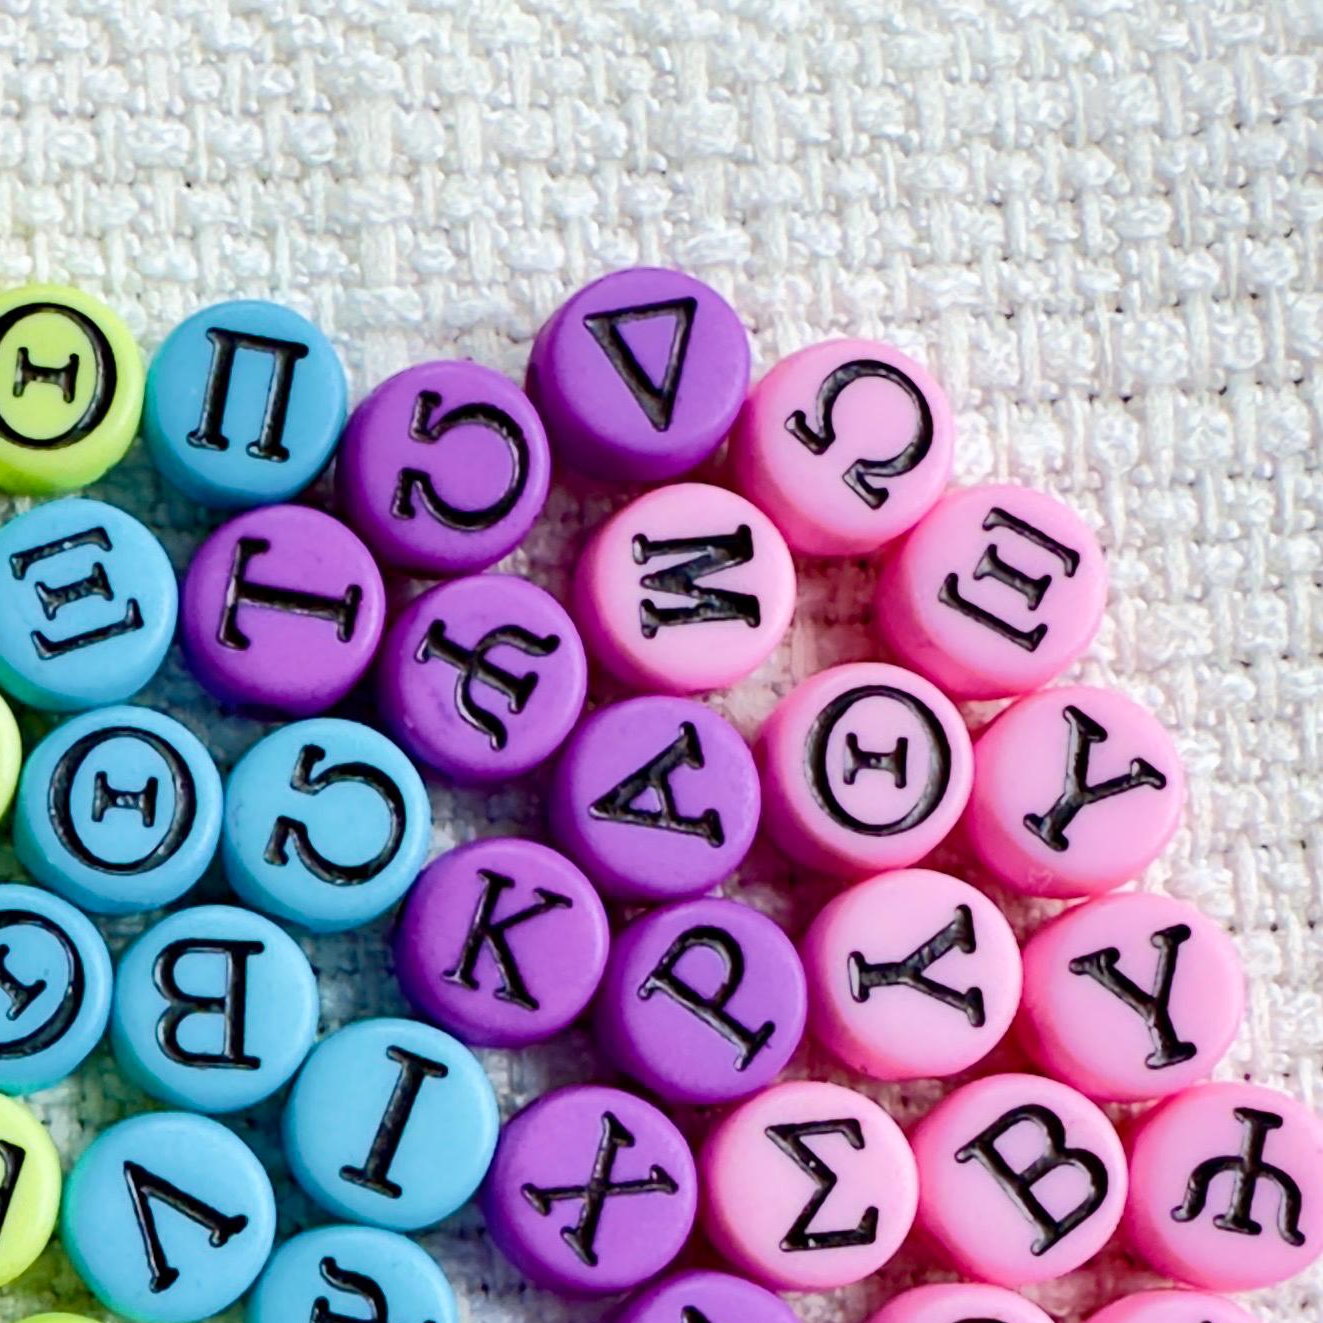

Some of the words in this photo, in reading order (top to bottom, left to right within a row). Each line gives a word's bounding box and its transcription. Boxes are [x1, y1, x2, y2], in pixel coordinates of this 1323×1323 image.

[186, 327, 309, 463] Π
[584, 297, 698, 432] Δ
[786, 359, 934, 510] Ω
[392, 390, 530, 533] Ω
[9, 526, 144, 658] Ξ
[939, 507, 1080, 653] Ξ
[420, 619, 561, 751] Ψ
[49, 726, 198, 875] Θ
[265, 744, 407, 886] Ω
[809, 684, 952, 837] Θ
[123, 1160, 248, 1293] Λ
[764, 1118, 879, 1253] Σ
[1172, 1107, 1306, 1247] Ψ
